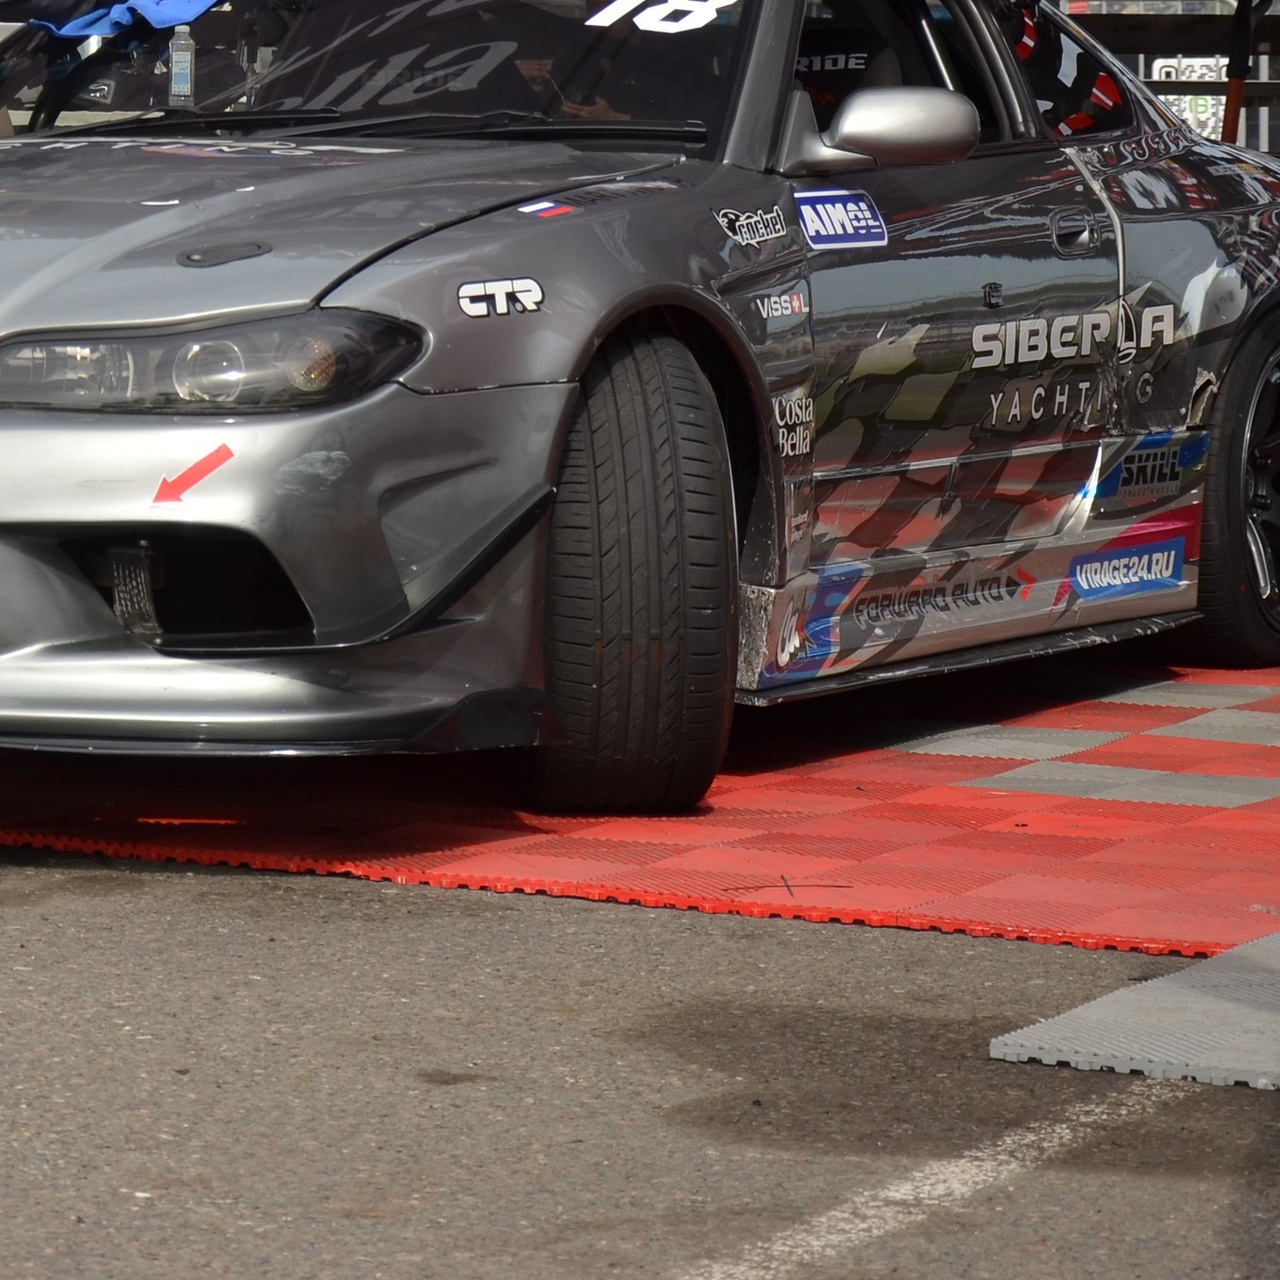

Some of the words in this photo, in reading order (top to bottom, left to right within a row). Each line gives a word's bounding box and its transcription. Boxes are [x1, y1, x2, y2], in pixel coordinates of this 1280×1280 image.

[736, 205, 787, 245] rocket
[800, 202, 883, 237] AIMOL
[774, 395, 814, 426] Costa
[990, 372, 1154, 427] YACHTIG
[779, 428, 811, 458] Bella
[1121, 450, 1180, 488] SKILL
[1076, 550, 1176, 590] VIRAGE24.RU
[854, 586, 949, 629] FORWARD
[950, 576, 1004, 612] AUTO
